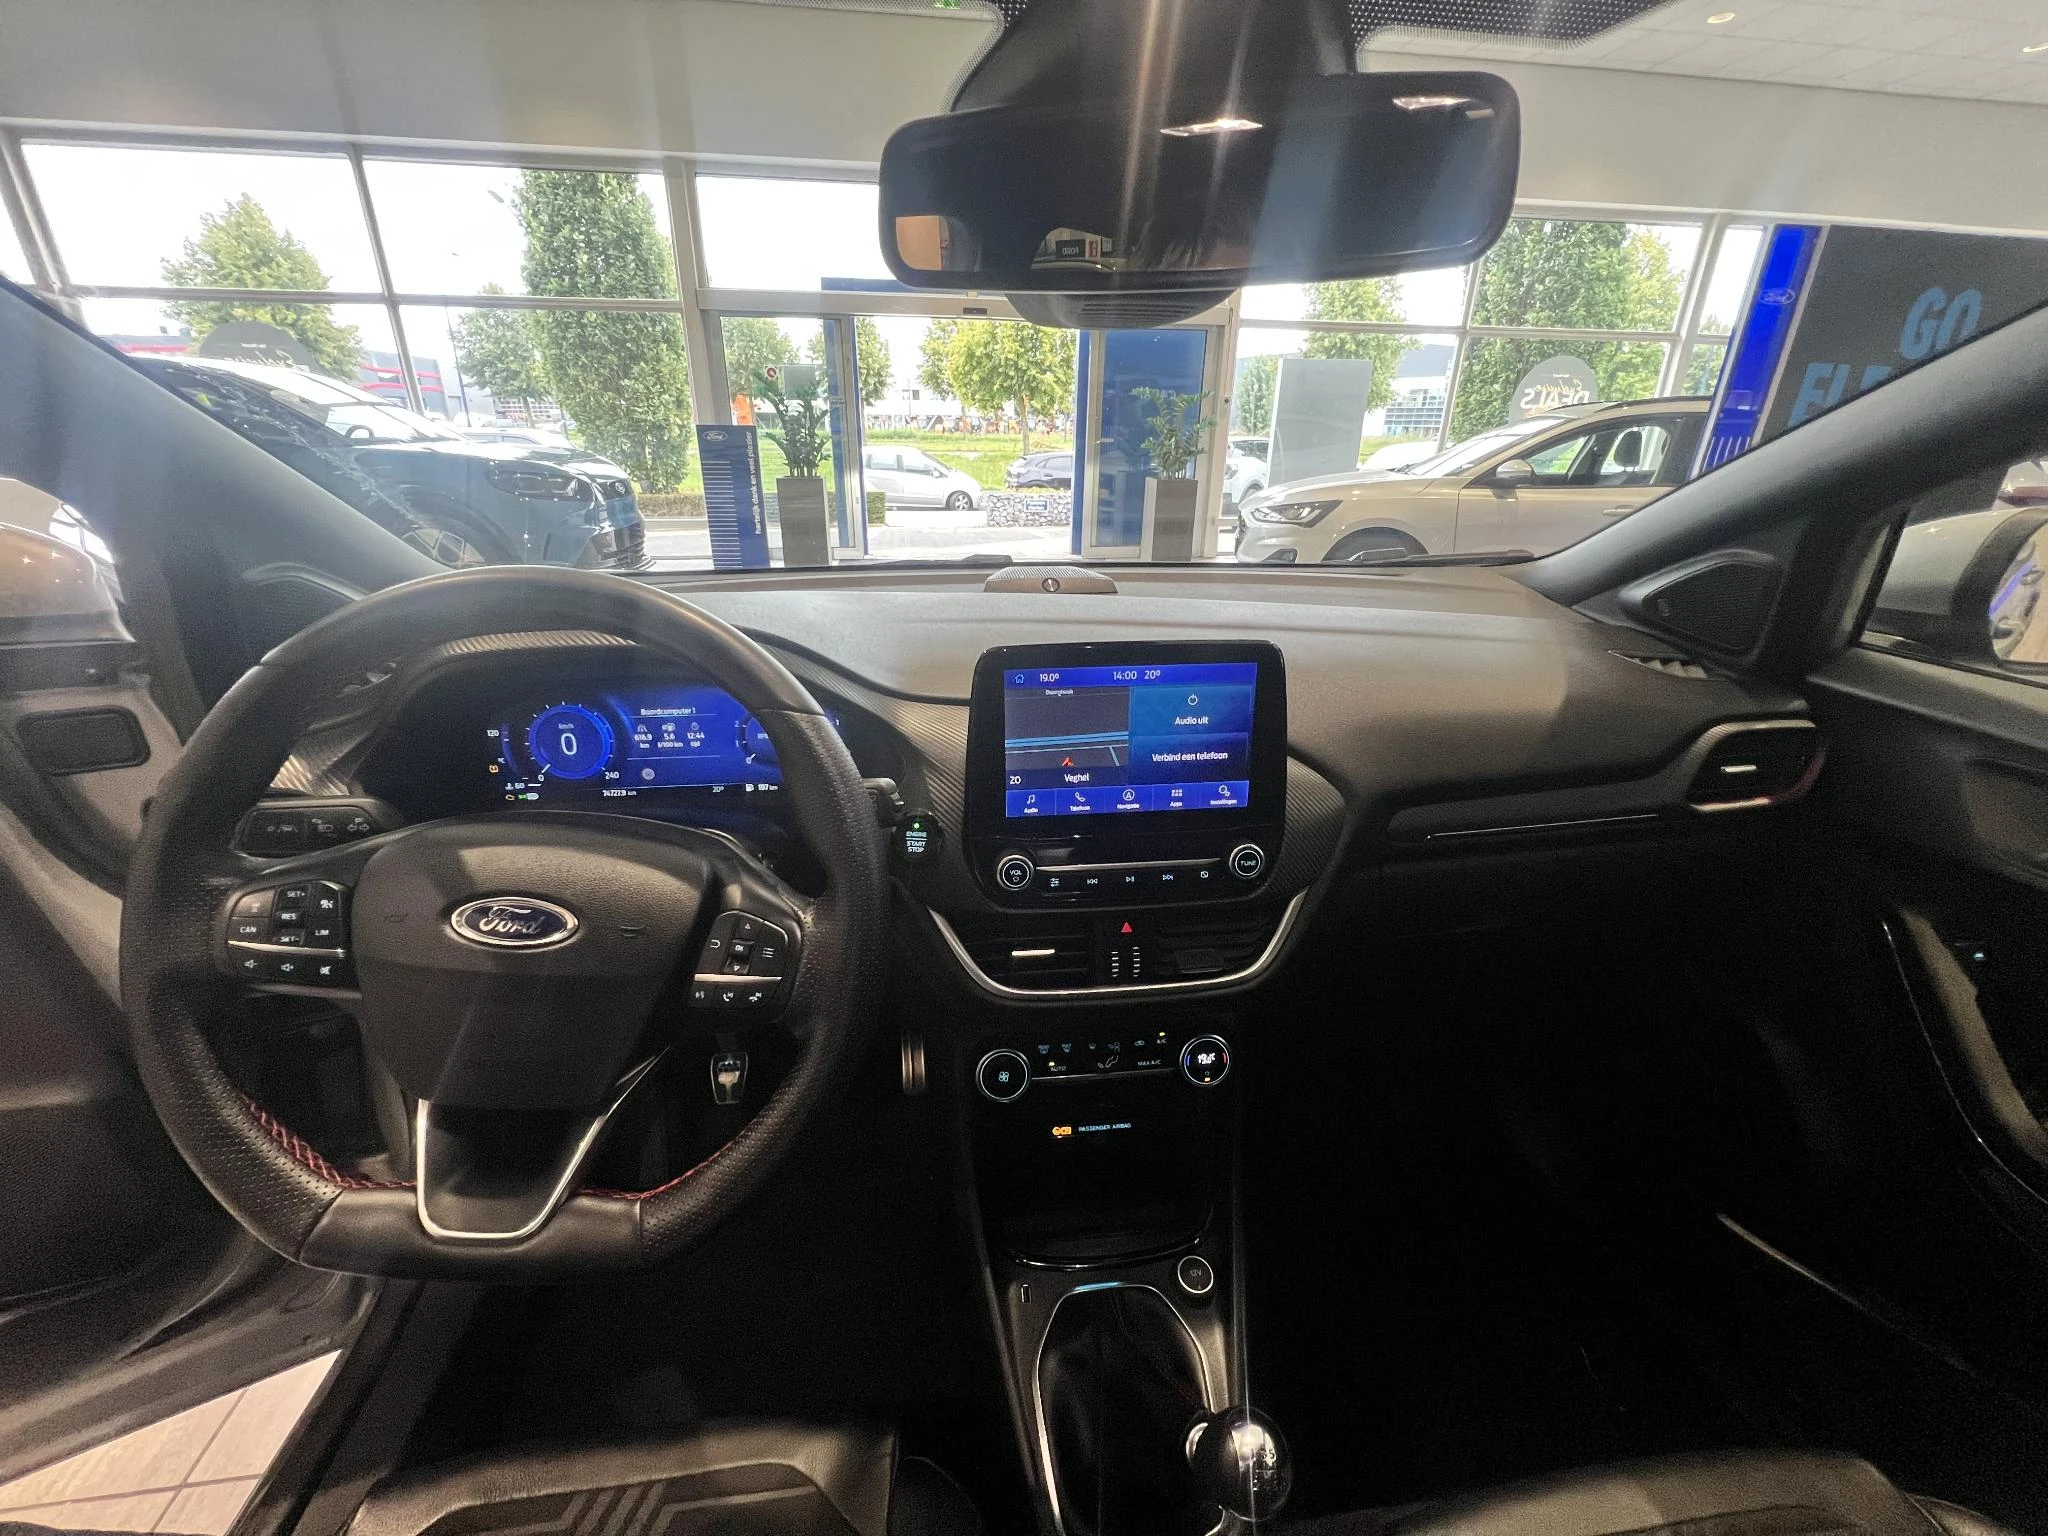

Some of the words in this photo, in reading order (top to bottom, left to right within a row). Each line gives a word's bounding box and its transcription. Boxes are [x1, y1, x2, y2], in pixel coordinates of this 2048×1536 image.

[1113, 670, 1138, 681] 14:00
[1175, 716, 1198, 725] Audio
[1197, 715, 1209, 724] uit
[486, 729, 500, 737] 120
[663, 732, 676, 740] 5.6
[687, 732, 705, 740] 12:44
[560, 732, 578, 756] 0
[1151, 753, 1181, 762] Verbind
[1196, 751, 1229, 760] telefoon
[604, 771, 620, 779] 240
[1064, 772, 1090, 784] Veghel
[479, 905, 545, 935] Ford
[734, 944, 744, 952] OK
